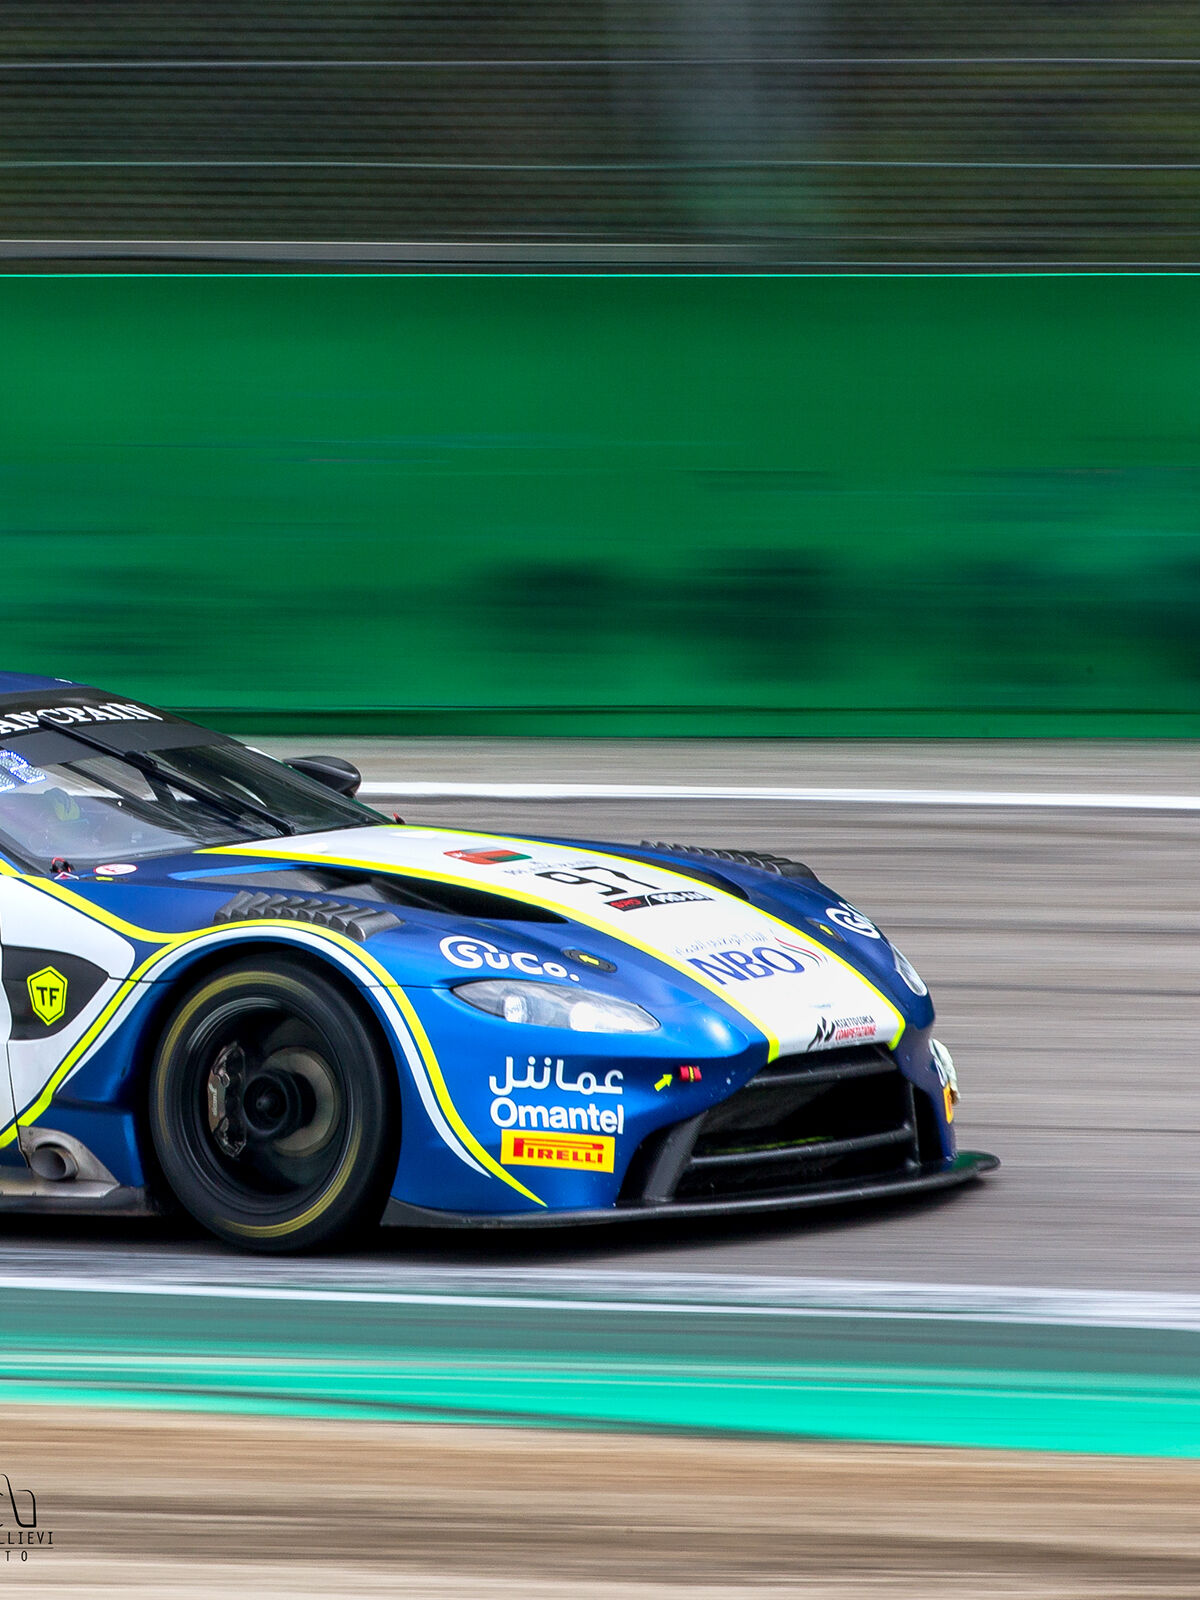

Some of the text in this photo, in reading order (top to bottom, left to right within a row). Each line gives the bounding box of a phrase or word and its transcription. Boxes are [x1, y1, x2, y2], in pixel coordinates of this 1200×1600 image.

[534, 865, 661, 897] 97
[686, 946, 805, 986] NBO
[36, 986, 60, 1007] TF
[490, 1097, 625, 1135] Omantel
[513, 1137, 605, 1164] PIRELLI
